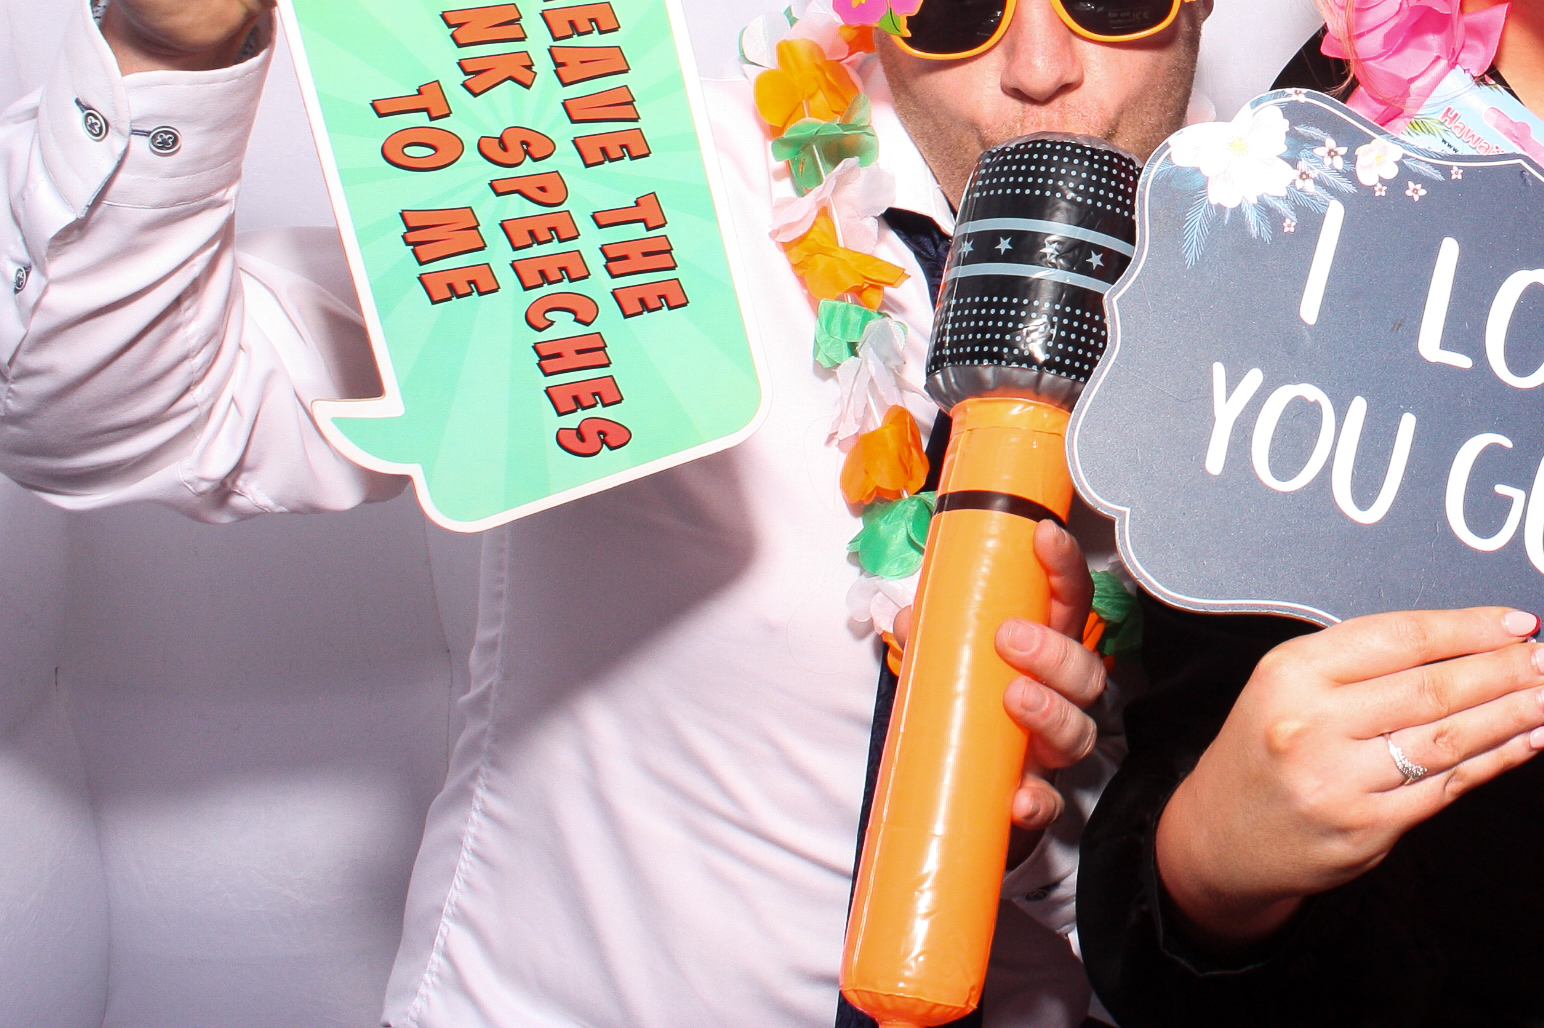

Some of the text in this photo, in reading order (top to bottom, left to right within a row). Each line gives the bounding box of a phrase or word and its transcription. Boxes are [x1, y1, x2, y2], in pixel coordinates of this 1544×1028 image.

[370, 79, 502, 306] TO ME
[591, 191, 690, 320] THE
[1299, 199, 1345, 325] I
[477, 125, 633, 459] SPEECHES
[1204, 360, 1417, 525] YOU
